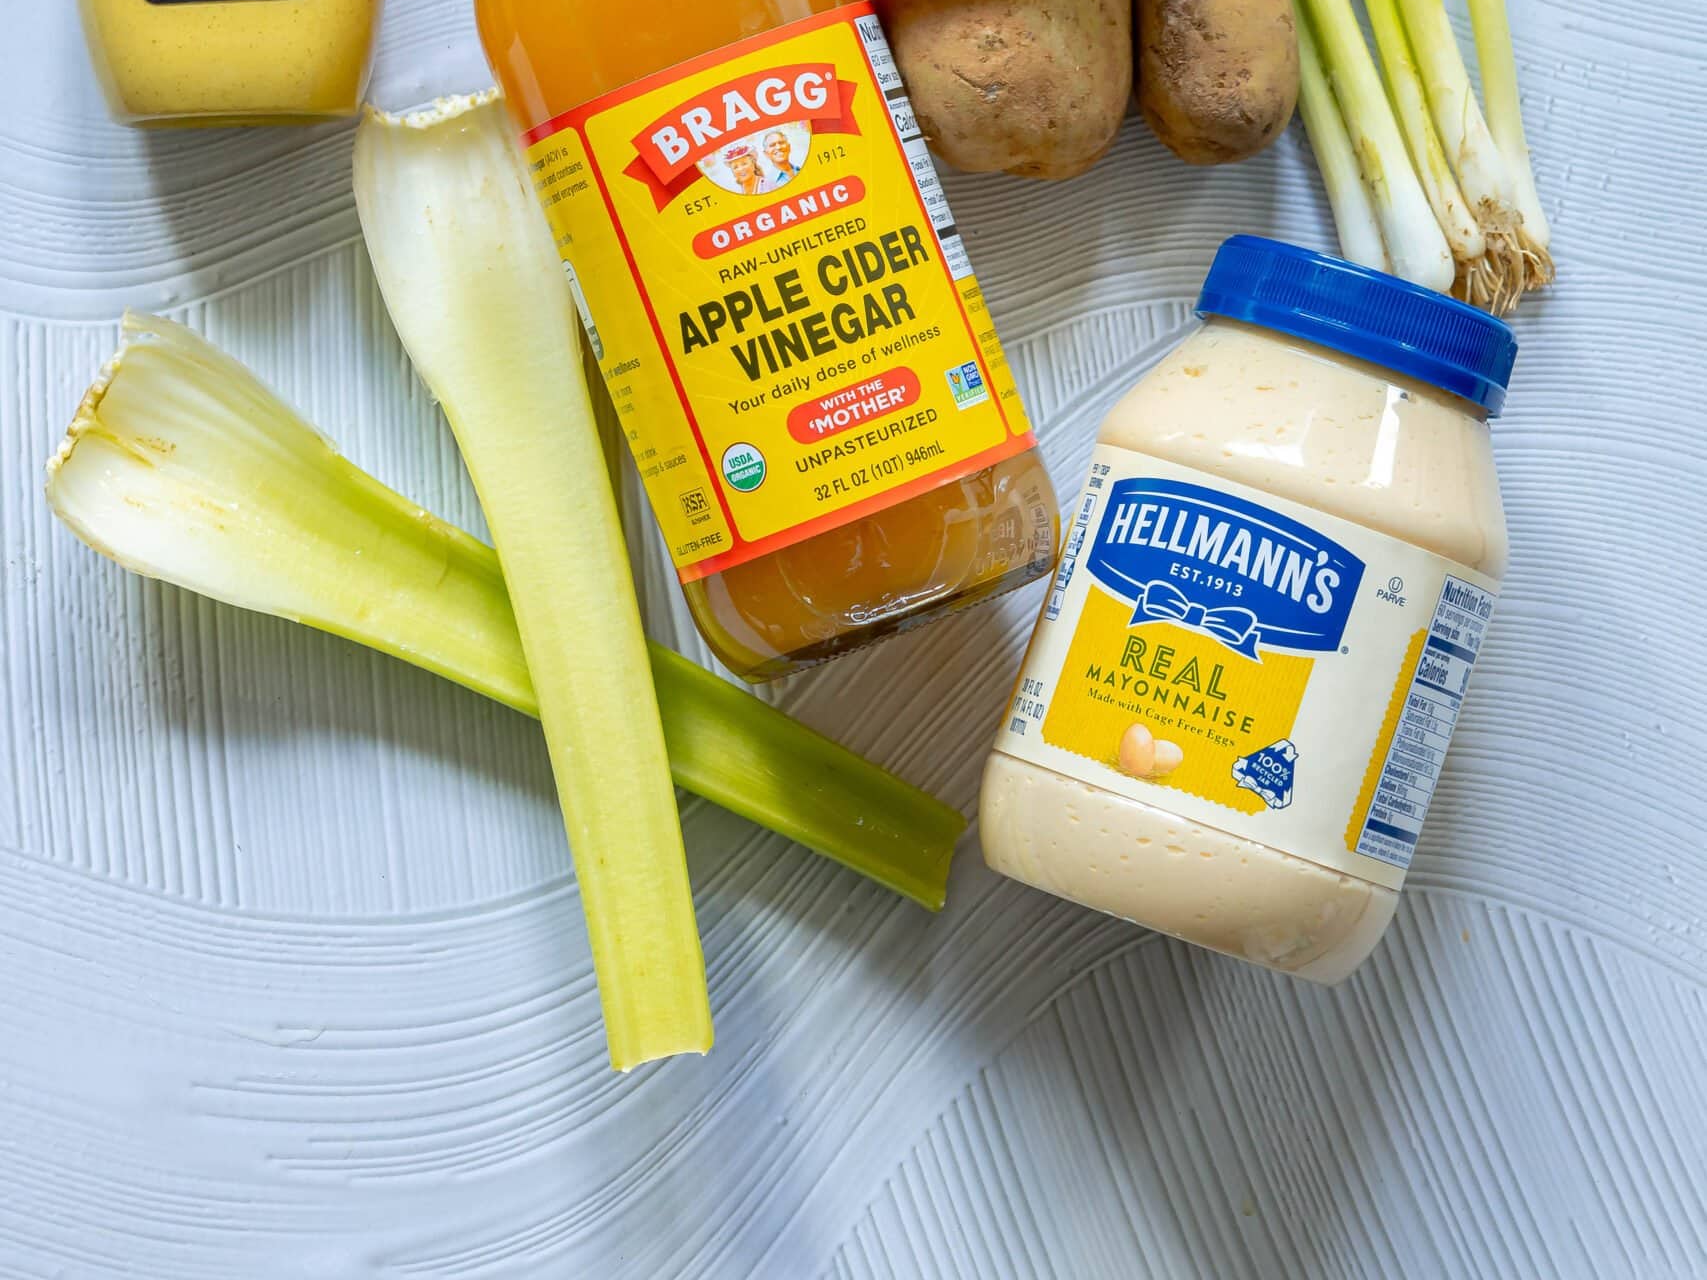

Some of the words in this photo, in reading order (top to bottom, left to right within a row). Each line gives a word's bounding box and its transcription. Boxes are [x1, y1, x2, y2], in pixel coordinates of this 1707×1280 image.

[651, 72, 828, 166] BRAGG
[684, 196, 718, 216] EST.
[816, 146, 847, 165] 1912
[711, 184, 849, 249] ORGANIC
[678, 268, 811, 355] APPLE
[817, 225, 930, 296] CIDER
[730, 283, 916, 382] VINEGAR
[728, 396, 767, 415] Your
[771, 375, 811, 400] daily
[816, 360, 857, 383] dose
[861, 347, 877, 365] of
[881, 326, 941, 356] wellness
[820, 391, 857, 411] WITH
[857, 379, 884, 398] THE
[728, 452, 754, 469] USDA
[796, 408, 938, 473] UNPASTEURIZED
[814, 484, 830, 502] 32
[832, 478, 850, 497] FL
[851, 469, 869, 487] OZ
[871, 454, 904, 481] (1QT)
[906, 440, 945, 466] 946mL
[676, 532, 723, 556] GLUTEN-FREE
[1106, 503, 1340, 614] HELLMANN'S
[1376, 589, 1406, 607] PARVE
[1443, 580, 1479, 613] Nutrition
[1086, 664, 1256, 734] MAYONNAISE
[1120, 635, 1227, 701] REAL
[1418, 656, 1449, 686] Calories
[1087, 687, 1116, 705] Made
[1118, 700, 1143, 715] with
[1145, 707, 1174, 726] Cage
[1177, 719, 1204, 737] Free
[1206, 729, 1236, 748] Eggs
[1252, 762, 1284, 788] RECYCLED
[1257, 752, 1291, 782] 100%
